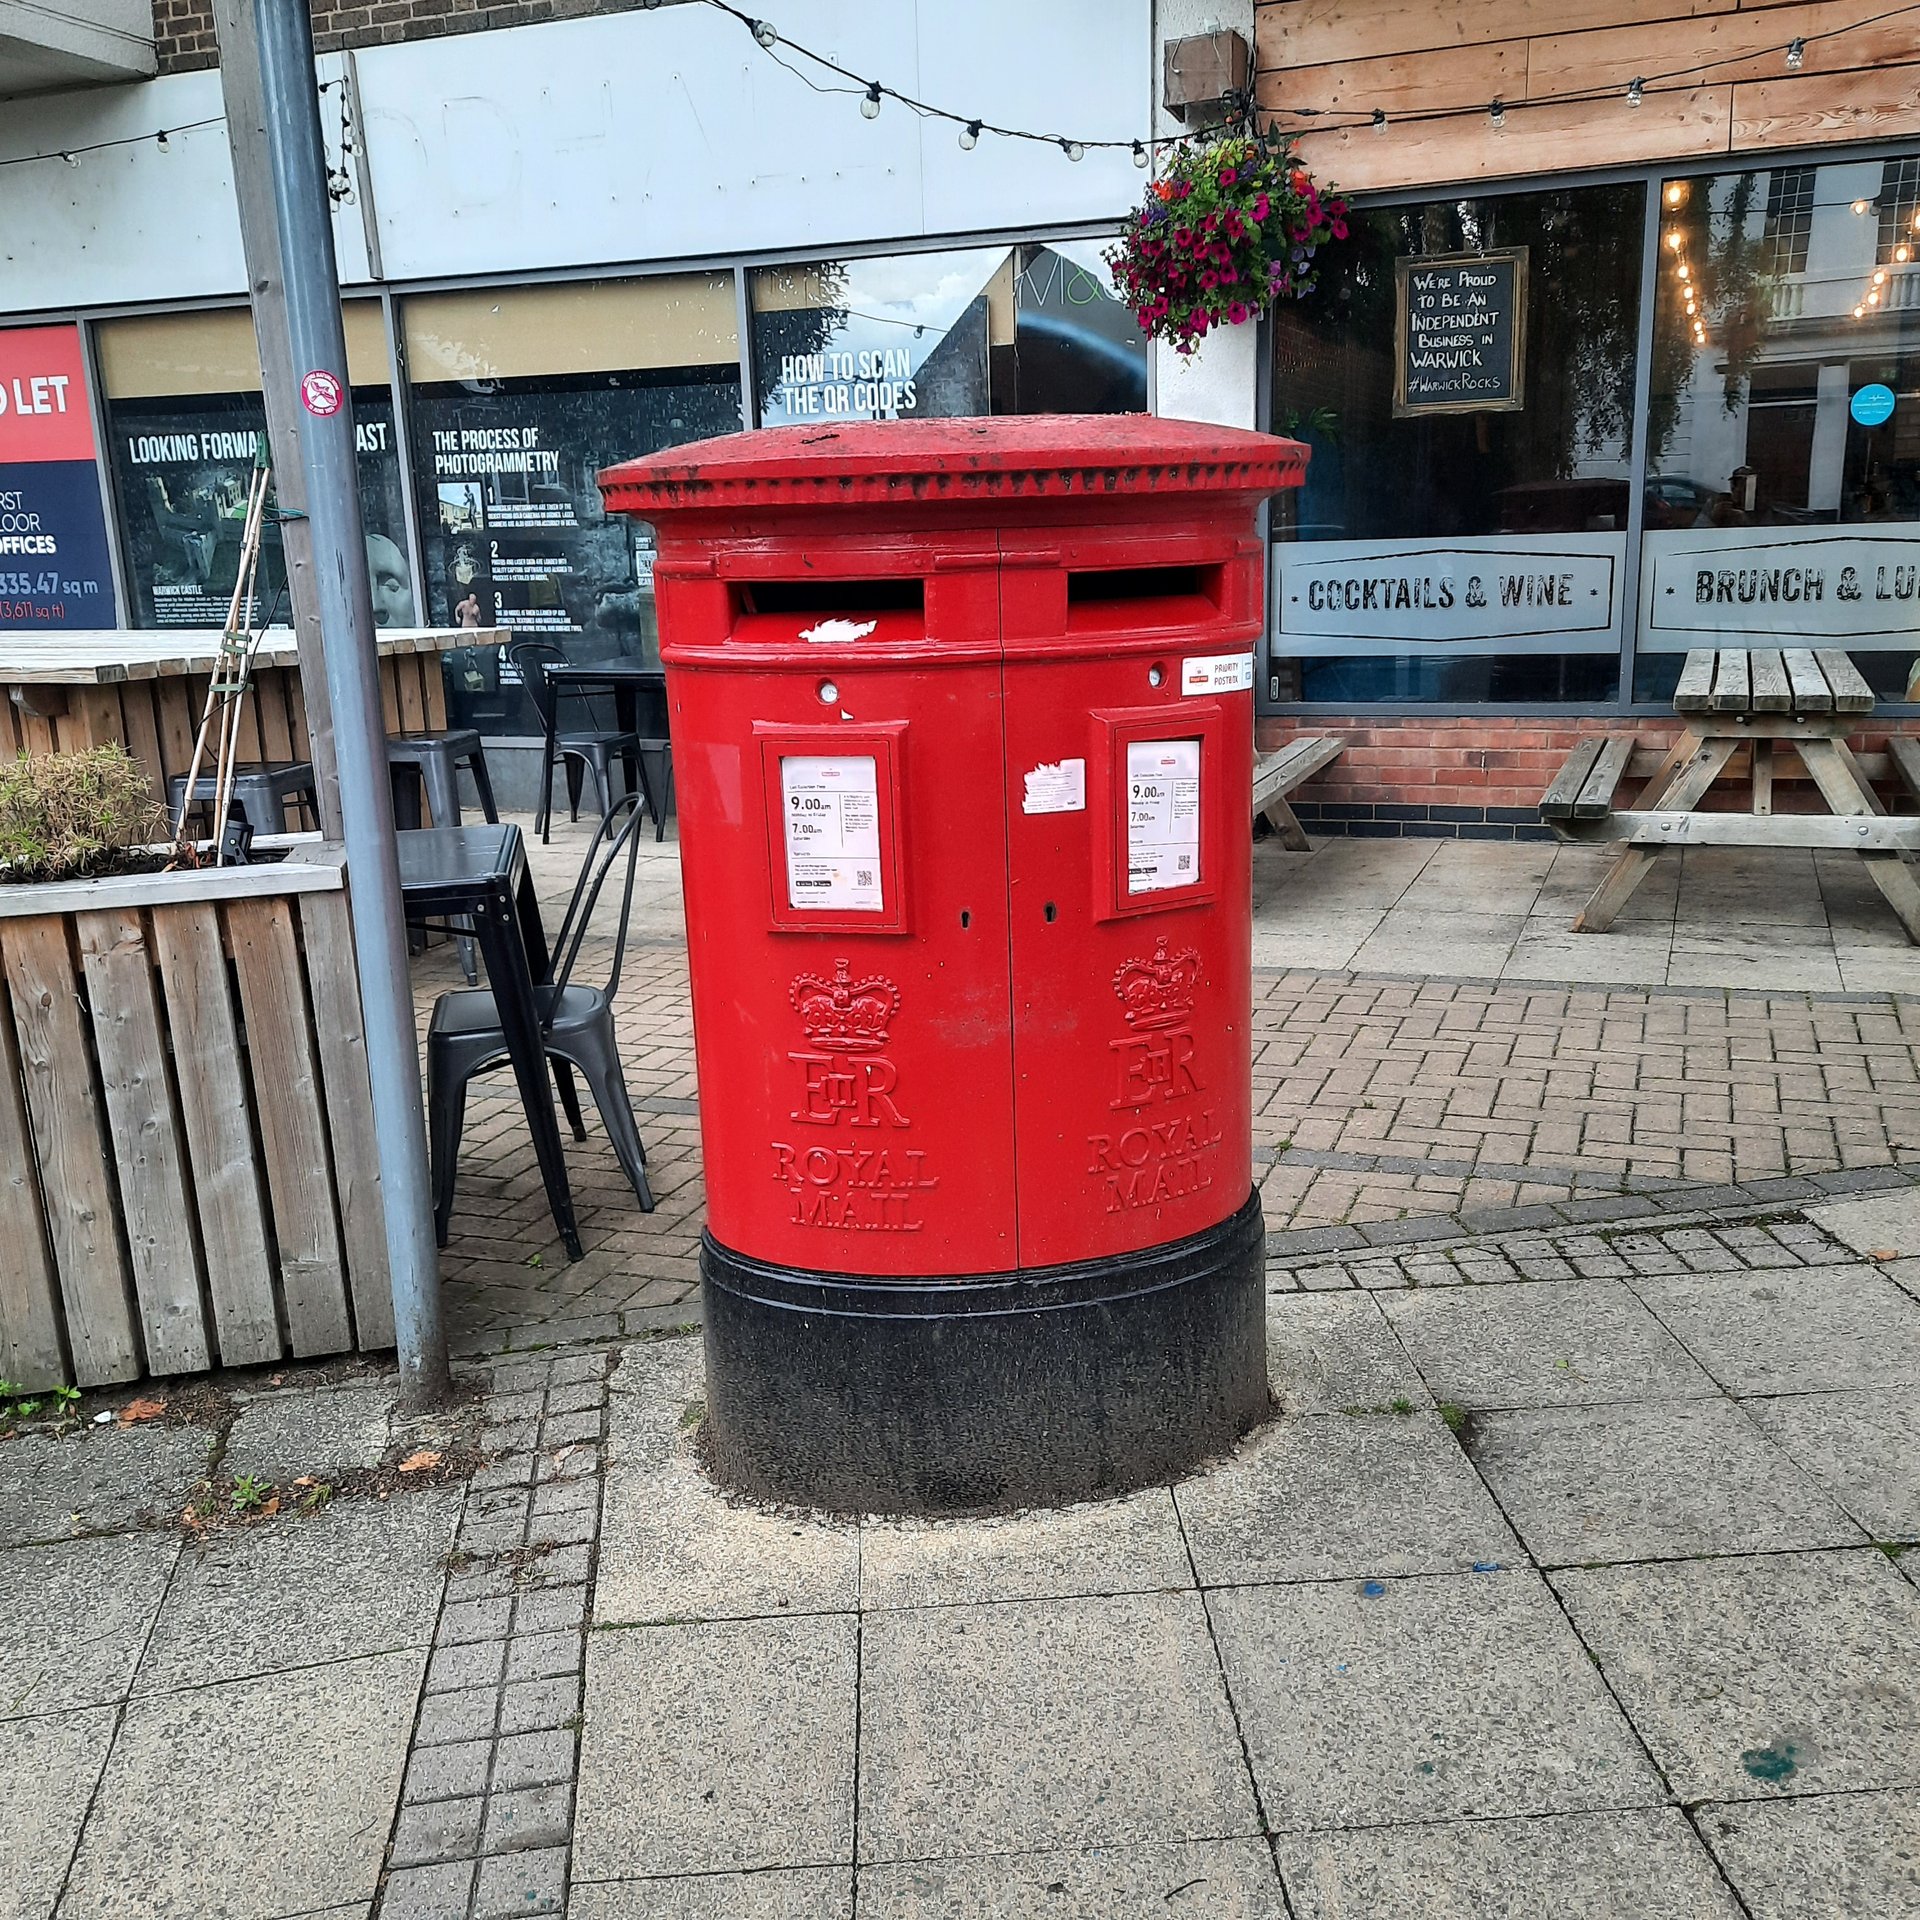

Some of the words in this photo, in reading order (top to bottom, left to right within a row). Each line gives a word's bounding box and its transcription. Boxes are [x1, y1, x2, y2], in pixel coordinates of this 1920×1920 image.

[1418, 295, 1435, 308] TO
[1442, 293, 1461, 307] BE
[1467, 292, 1486, 307] AN
[1411, 312, 1499, 332] INDEPENDENT
[1418, 333, 1474, 348] BUSINESS
[1482, 333, 1493, 345] IN
[782, 353, 825, 384] HOW
[829, 352, 854, 381] TO
[858, 348, 911, 380] SCAN
[1410, 349, 1482, 369] WARWICK
[12, 375, 69, 415] LET
[783, 385, 819, 415] THE
[823, 384, 850, 414] QR
[854, 380, 917, 412] CODES
[128, 433, 199, 463] LOOKING
[201, 430, 259, 460] FORWA
[432, 430, 458, 451] THE
[461, 428, 520, 450] PROCESS
[522, 427, 539, 448] OF
[434, 451, 559, 474] PHOTOGRAMMETRY
[487, 486, 493, 504] 1
[0, 535, 57, 554] FFICES
[490, 541, 499, 558] 2
[180, 584, 203, 595] CASTLE
[1308, 577, 1455, 611] COCKTAILS
[1466, 576, 1487, 608] &
[1499, 573, 1574, 607] WINE
[1696, 568, 1825, 604] BRUNCH
[1836, 566, 1862, 601] &
[1875, 565, 1920, 601] LU
[494, 591, 502, 608] 3
[36, 606, 50, 620] sq
[52, 601, 65, 619] ft)
[498, 645, 507, 661] 4
[790, 795, 832, 811] 9.00am
[792, 823, 823, 834] 7.00am
[1087, 1108, 1223, 1174] ROYAL
[771, 1142, 941, 1189] ROYAL
[1106, 1154, 1213, 1214] MAIL
[790, 1187, 924, 1232] MAIL
